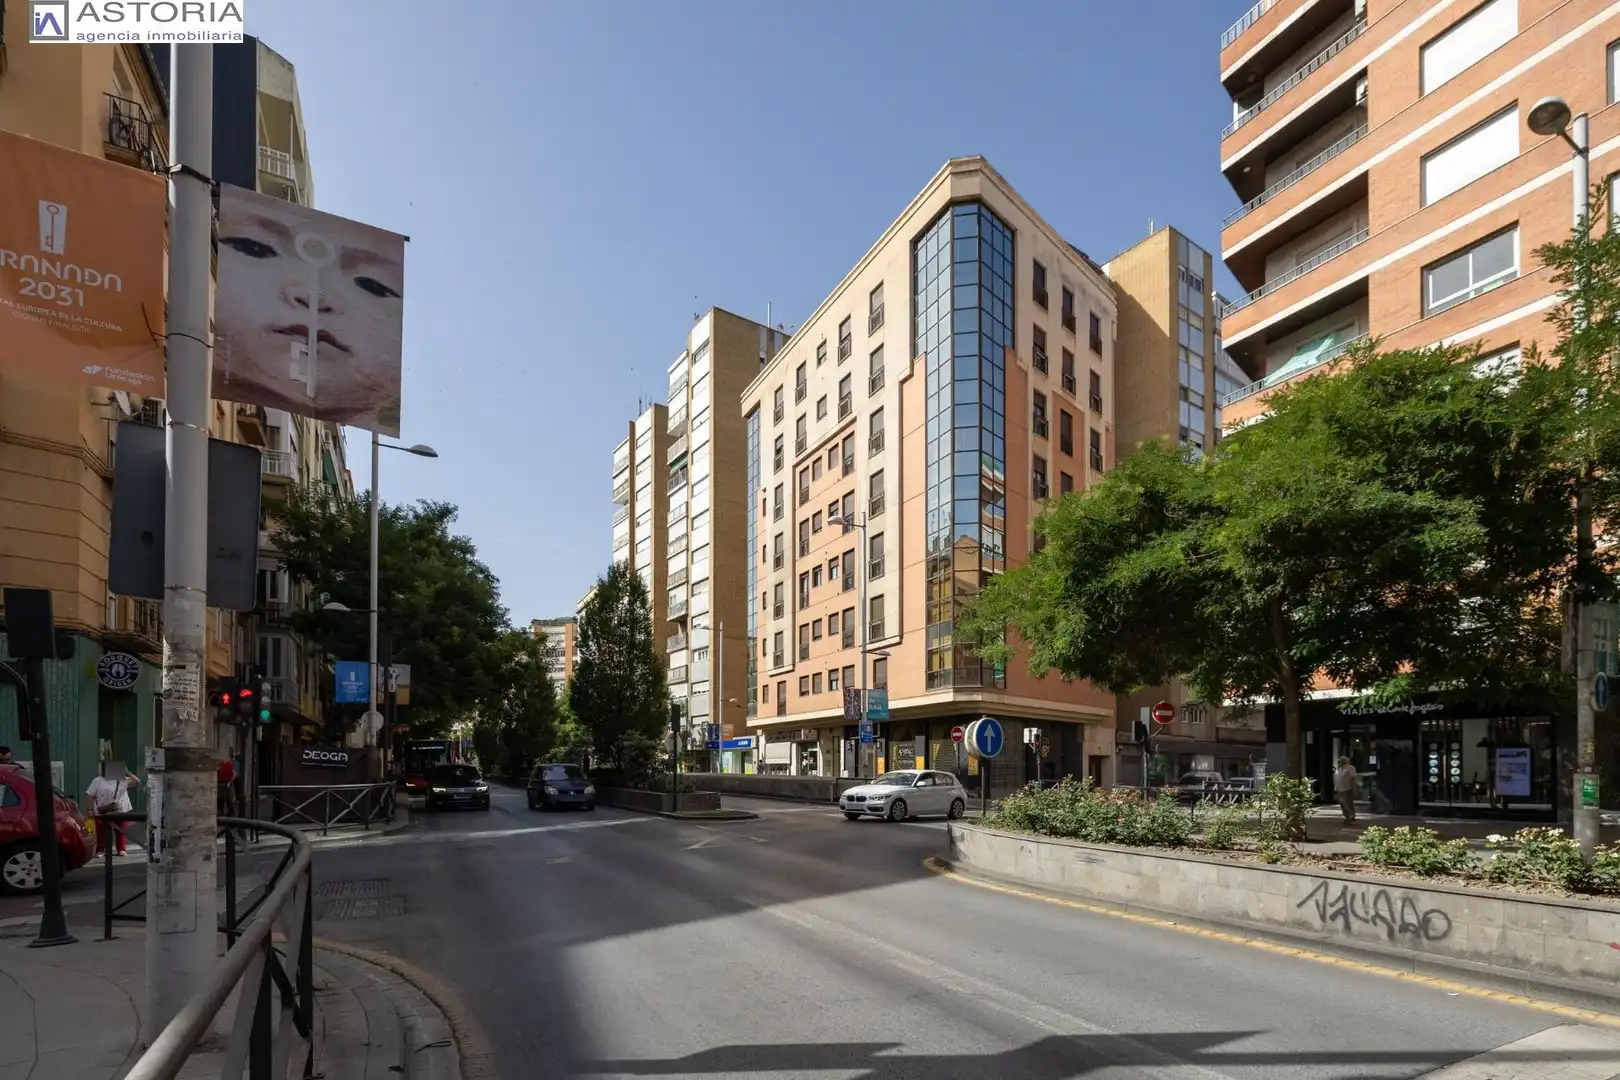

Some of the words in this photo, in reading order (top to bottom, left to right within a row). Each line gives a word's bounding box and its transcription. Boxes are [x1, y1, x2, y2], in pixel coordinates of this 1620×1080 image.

[19, 277, 85, 307] 2031
[16, 303, 57, 316] EUROPEA
[71, 314, 83, 323] LA
[84, 316, 123, 332] CULTURA
[102, 676, 133, 687] ORIGEN
